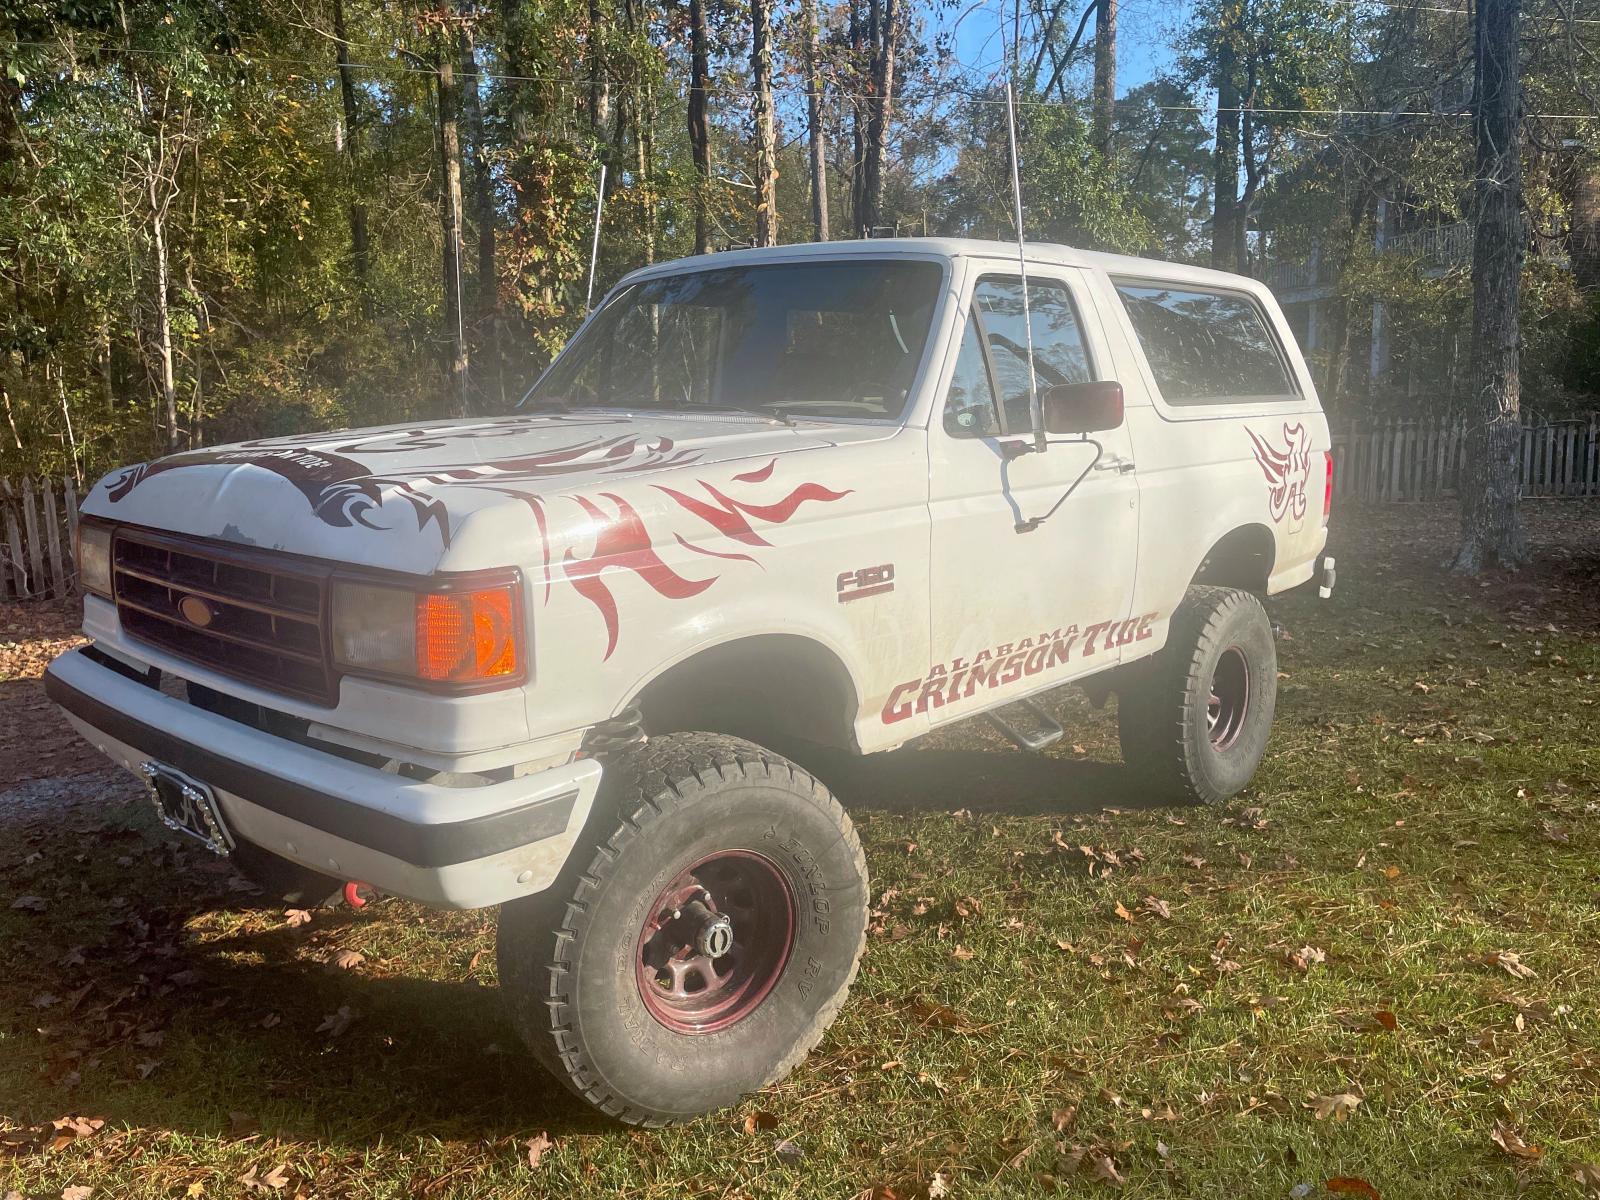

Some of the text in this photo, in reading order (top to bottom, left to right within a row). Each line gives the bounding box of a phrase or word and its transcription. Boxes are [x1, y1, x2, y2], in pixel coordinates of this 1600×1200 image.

[882, 612, 1159, 725] CRIMSON TIDE
[926, 624, 1079, 680] ALABAMA
[779, 838, 830, 935] DUNLOP
